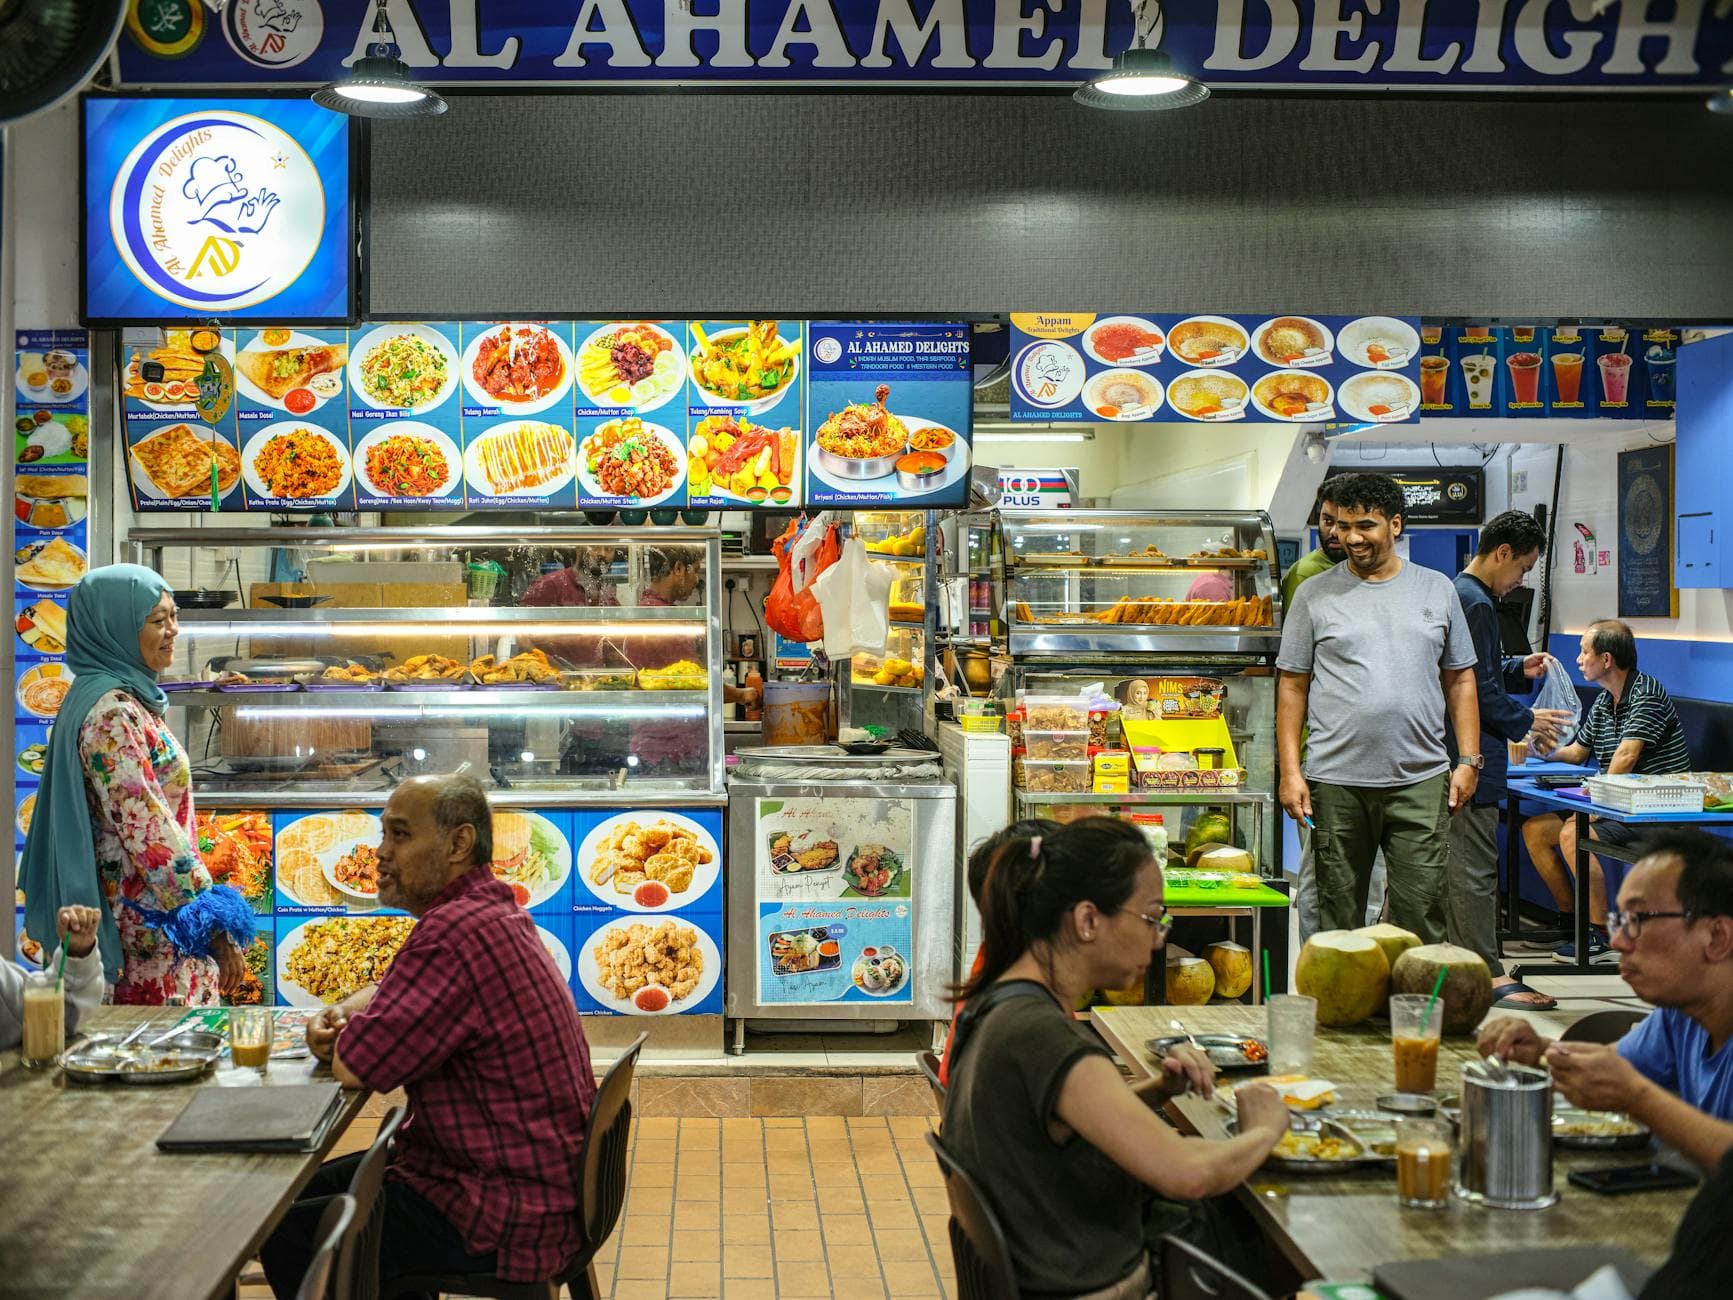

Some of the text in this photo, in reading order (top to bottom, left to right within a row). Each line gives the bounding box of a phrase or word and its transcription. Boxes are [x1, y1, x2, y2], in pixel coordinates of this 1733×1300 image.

[1203, 0, 1733, 75] DELIGH
[159, 128, 213, 178] Delights
[151, 184, 171, 252] Ahamed
[1036, 315, 1072, 327] Appam
[847, 341, 970, 354] AL AHAMED DELIGHTS
[239, 411, 273, 419] Masala Dosai
[365, 411, 385, 420] Goreng
[464, 409, 482, 417] Tulang
[577, 408, 635, 417] Chicken/Mutton Chop
[733, 408, 747, 416] Soup
[1013, 411, 1083, 419] AL AHAMED DELIGHTS
[1003, 475, 1041, 495] 100
[580, 498, 622, 506] Chicken/Mutton
[1003, 496, 1040, 506] PLUS
[801, 906, 842, 919] Ahamed
[844, 906, 891, 920] Delights
